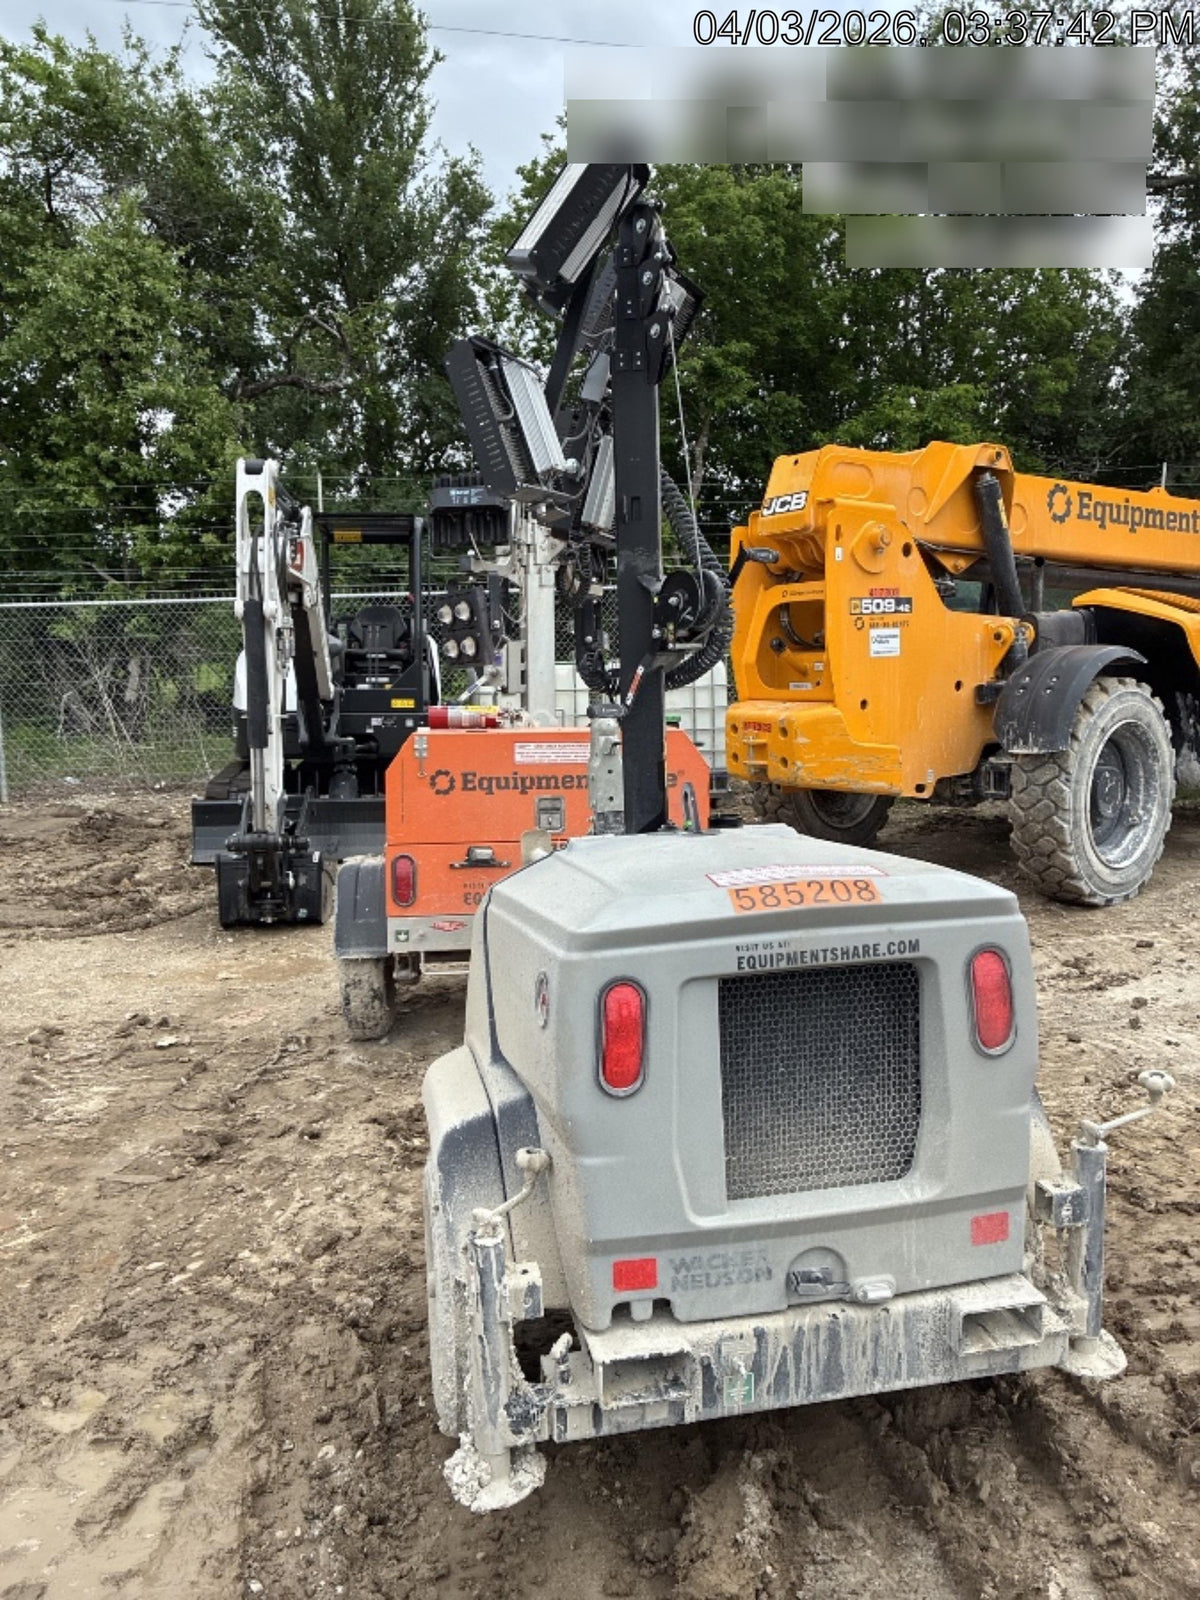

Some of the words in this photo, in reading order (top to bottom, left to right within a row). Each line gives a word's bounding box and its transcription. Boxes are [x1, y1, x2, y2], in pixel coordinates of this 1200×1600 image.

[762, 491, 807, 517] JCB
[735, 879, 876, 911] 585208
[736, 938, 921, 971] EQUIPMENTSHARE.COM
[762, 941, 775, 950] US
